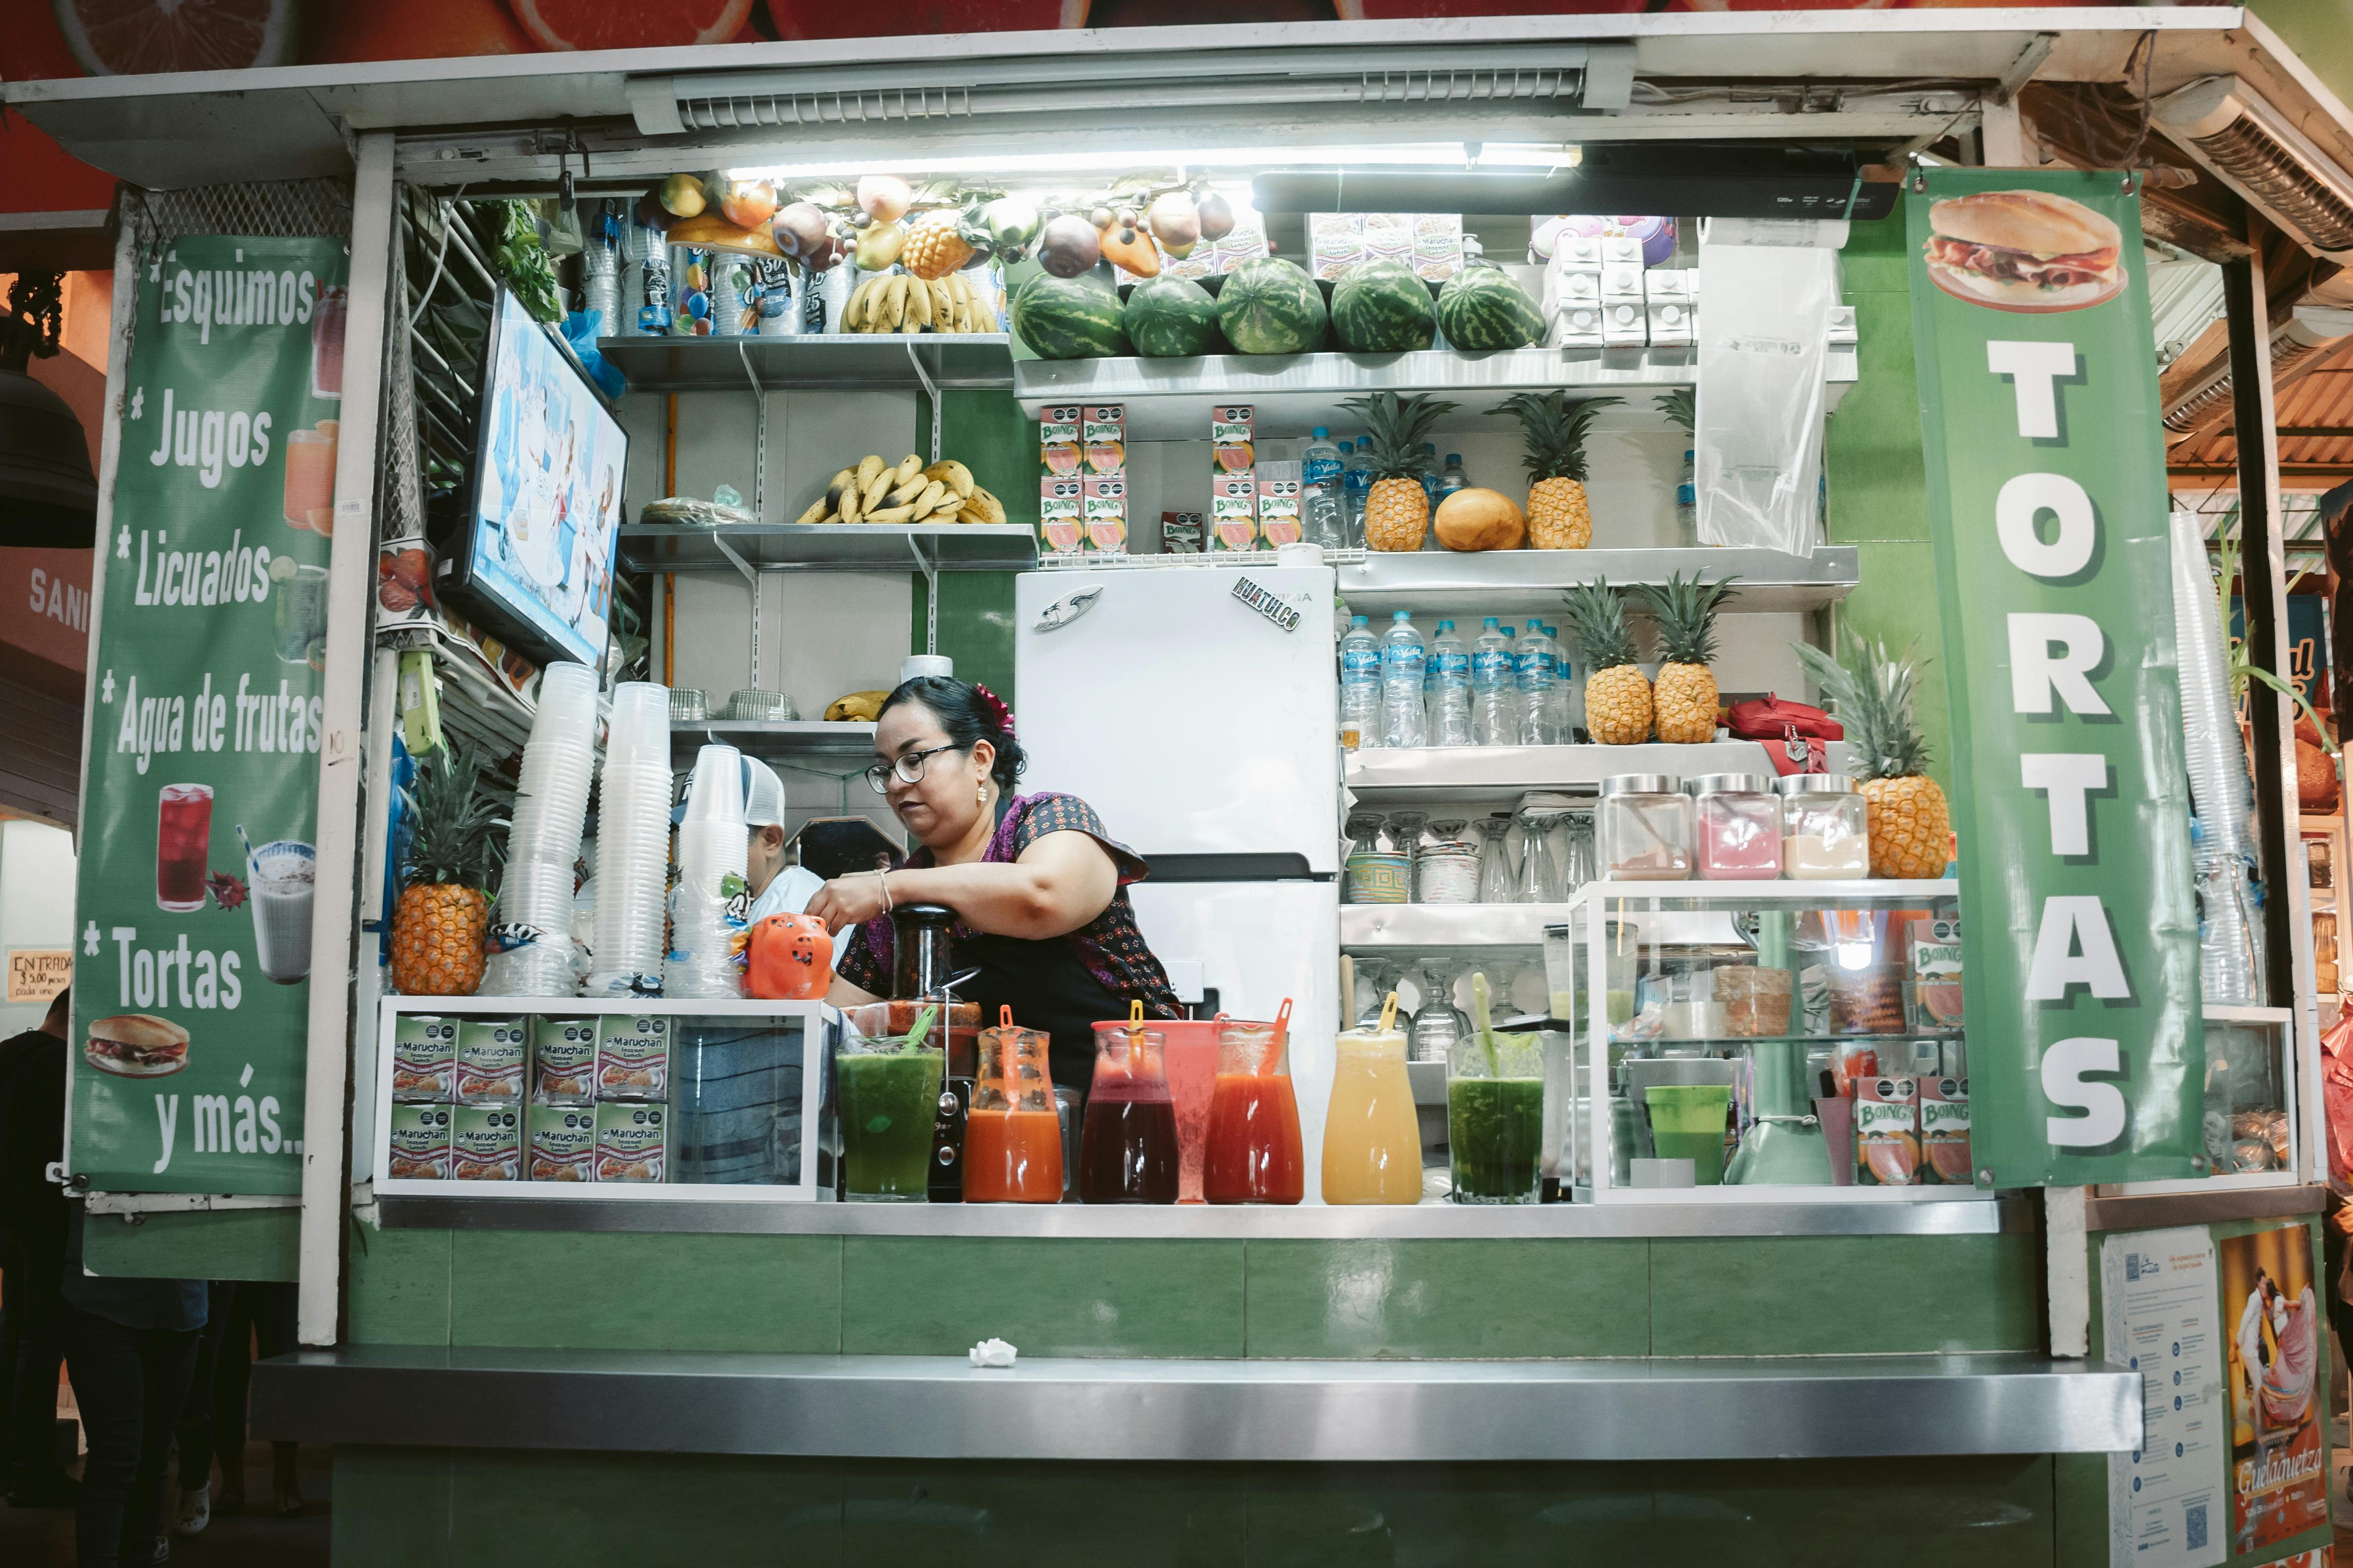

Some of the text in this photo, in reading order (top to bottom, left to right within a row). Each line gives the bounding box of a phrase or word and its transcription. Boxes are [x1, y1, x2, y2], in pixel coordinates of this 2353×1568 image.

[150, 388, 272, 488] Jugos
[134, 529, 271, 608] Licuados
[1231, 575, 1301, 631] HUATULCO
[117, 673, 322, 775] Agua de frutas
[1987, 340, 2130, 1146] TORTAS
[14, 956, 73, 971] ENTRADA
[112, 926, 242, 1010] Tortas
[15, 985, 35, 995] cada
[403, 1042, 451, 1053] Maruchan
[544, 1044, 590, 1055] Maruchan
[614, 1037, 662, 1047] Maruchan
[471, 1047, 521, 1057] Maruchan
[1861, 1104, 1915, 1127] BOING!
[153, 1093, 179, 1175] y
[399, 1128, 446, 1140] Maruchan
[466, 1131, 513, 1141] Maruchan
[542, 1131, 590, 1143] Maruchan
[610, 1128, 659, 1139] Maruchan
[2238, 1447, 2322, 1505] Guelaguetza
